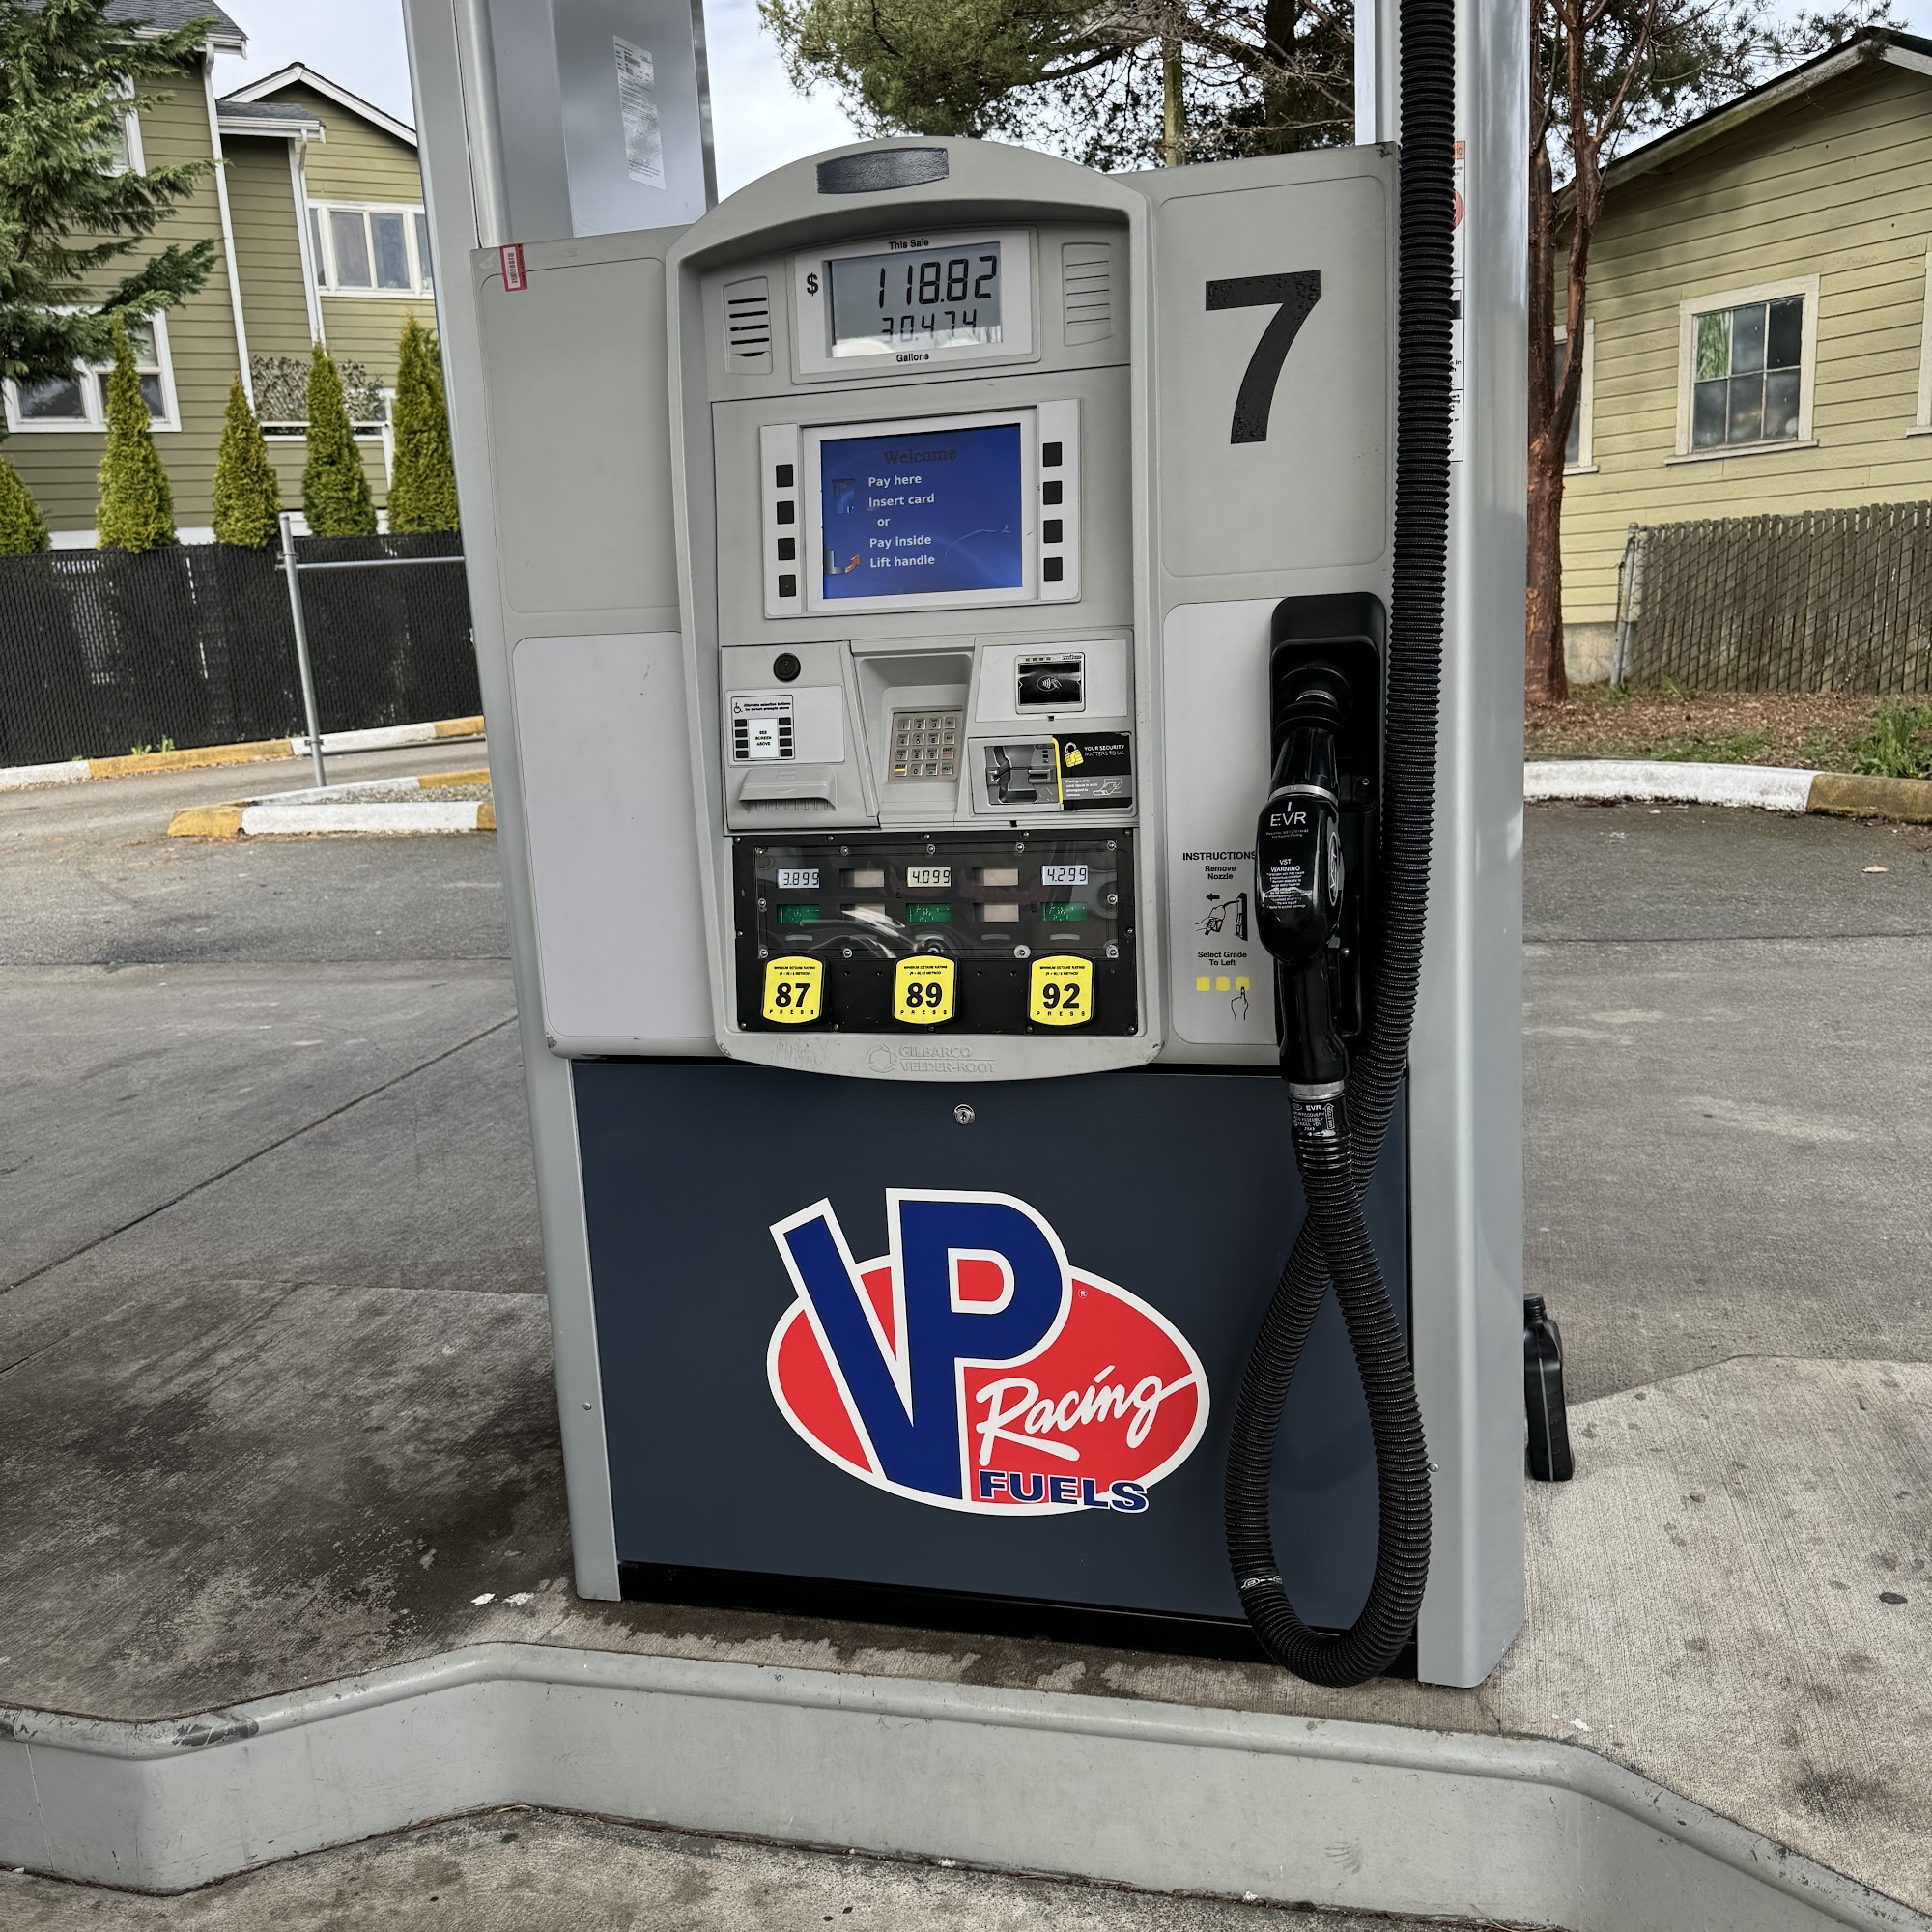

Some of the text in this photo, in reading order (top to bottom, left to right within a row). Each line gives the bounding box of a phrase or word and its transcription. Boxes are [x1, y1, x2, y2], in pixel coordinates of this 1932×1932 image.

[889, 239, 929, 250] This Sale
[806, 272, 819, 297] $
[878, 255, 997, 309] 118.82
[881, 309, 977, 343] 30.474
[895, 353, 929, 363] Gallons
[1206, 270, 1321, 444] 7
[883, 448, 956, 465] Welcome
[868, 474, 922, 488] Pay here
[868, 494, 935, 508] Insert card
[877, 517, 890, 526] or
[869, 535, 932, 550] Pay inside
[870, 554, 935, 568] Lift handle
[1270, 811, 1306, 826] EVR
[1182, 851, 1256, 861] INSTRUCTIONS
[783, 871, 820, 886] 3.899
[912, 870, 951, 884] 4.099
[1047, 867, 1087, 882] 4.299
[1198, 951, 1247, 959] Select Grade
[775, 982, 810, 1008] 87
[906, 982, 943, 1008] 89
[1042, 982, 1080, 1009] 92
[899, 1045, 972, 1059] GILBARCO
[899, 1060, 996, 1074] VEEDER-ROOT
[773, 1189, 1069, 1502] VP
[977, 1365, 1194, 1466] Racing
[979, 1469, 1149, 1513] FUELS
